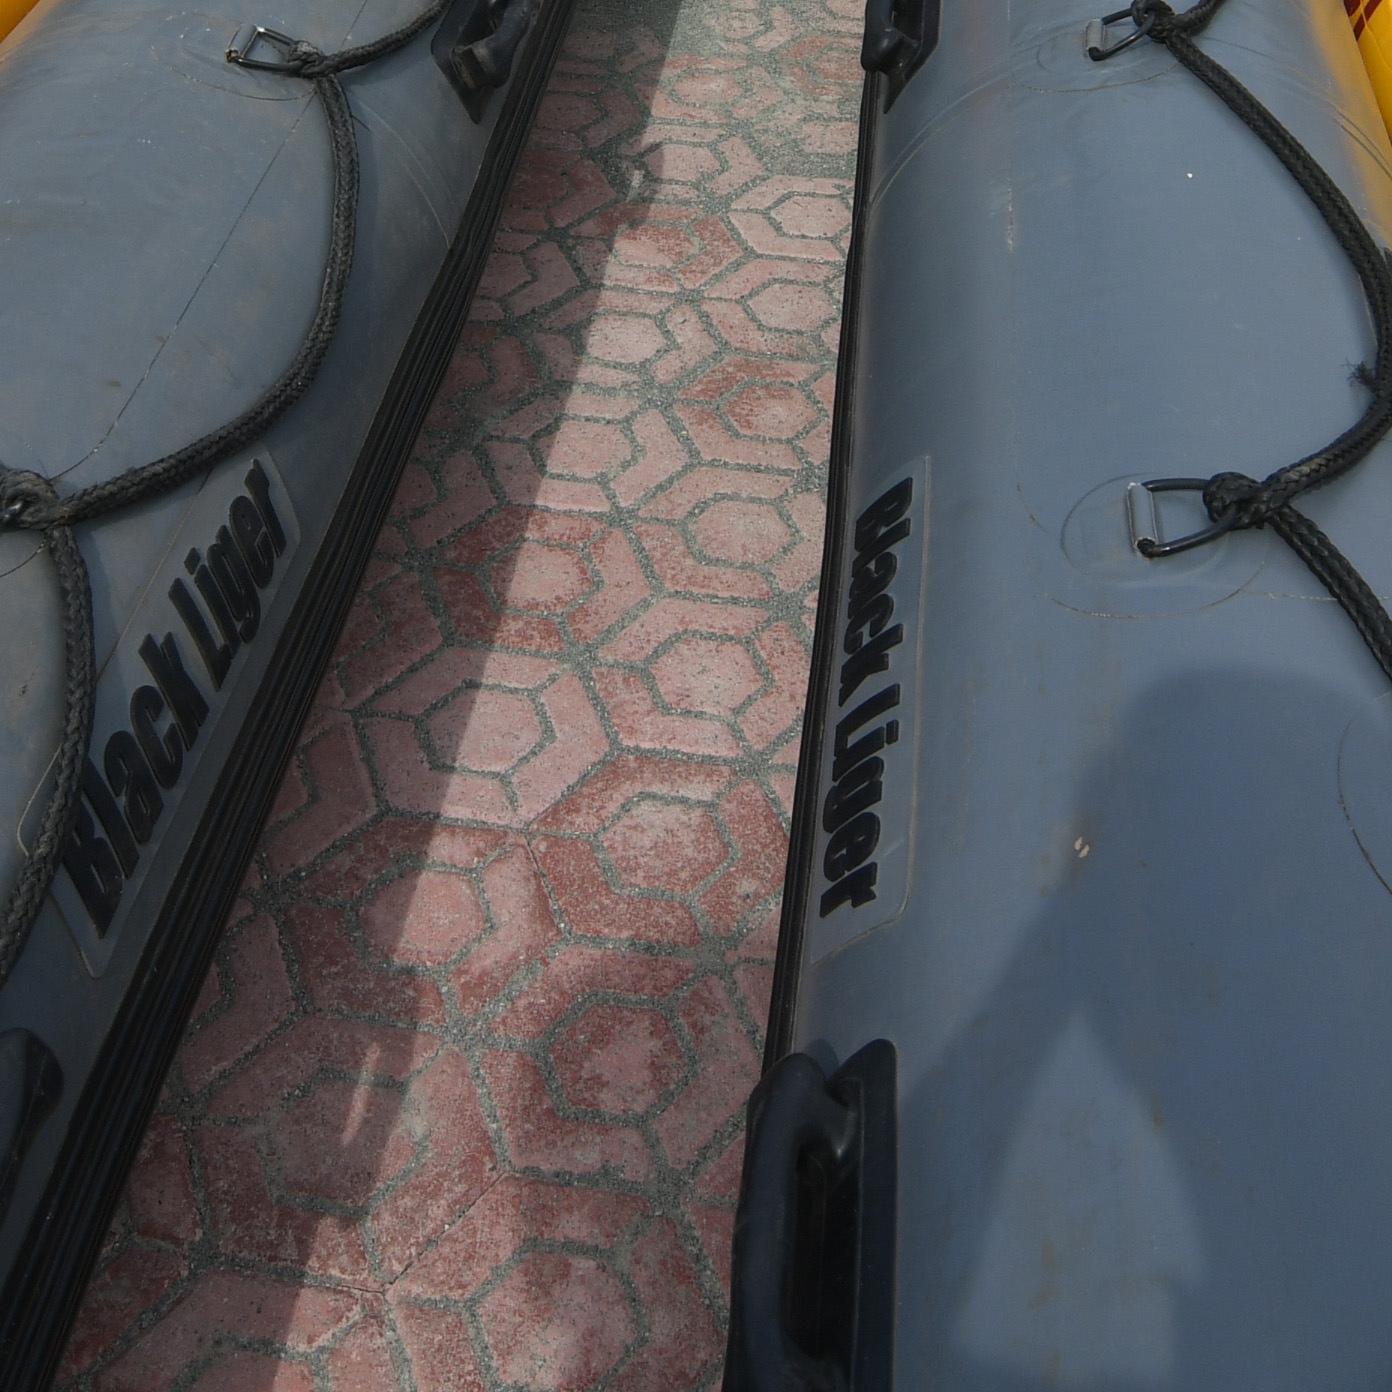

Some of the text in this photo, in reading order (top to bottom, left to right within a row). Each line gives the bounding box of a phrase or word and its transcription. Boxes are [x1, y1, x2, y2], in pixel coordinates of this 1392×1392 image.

[63, 457, 288, 940] Black Liger
[819, 476, 914, 920] Black Liger
